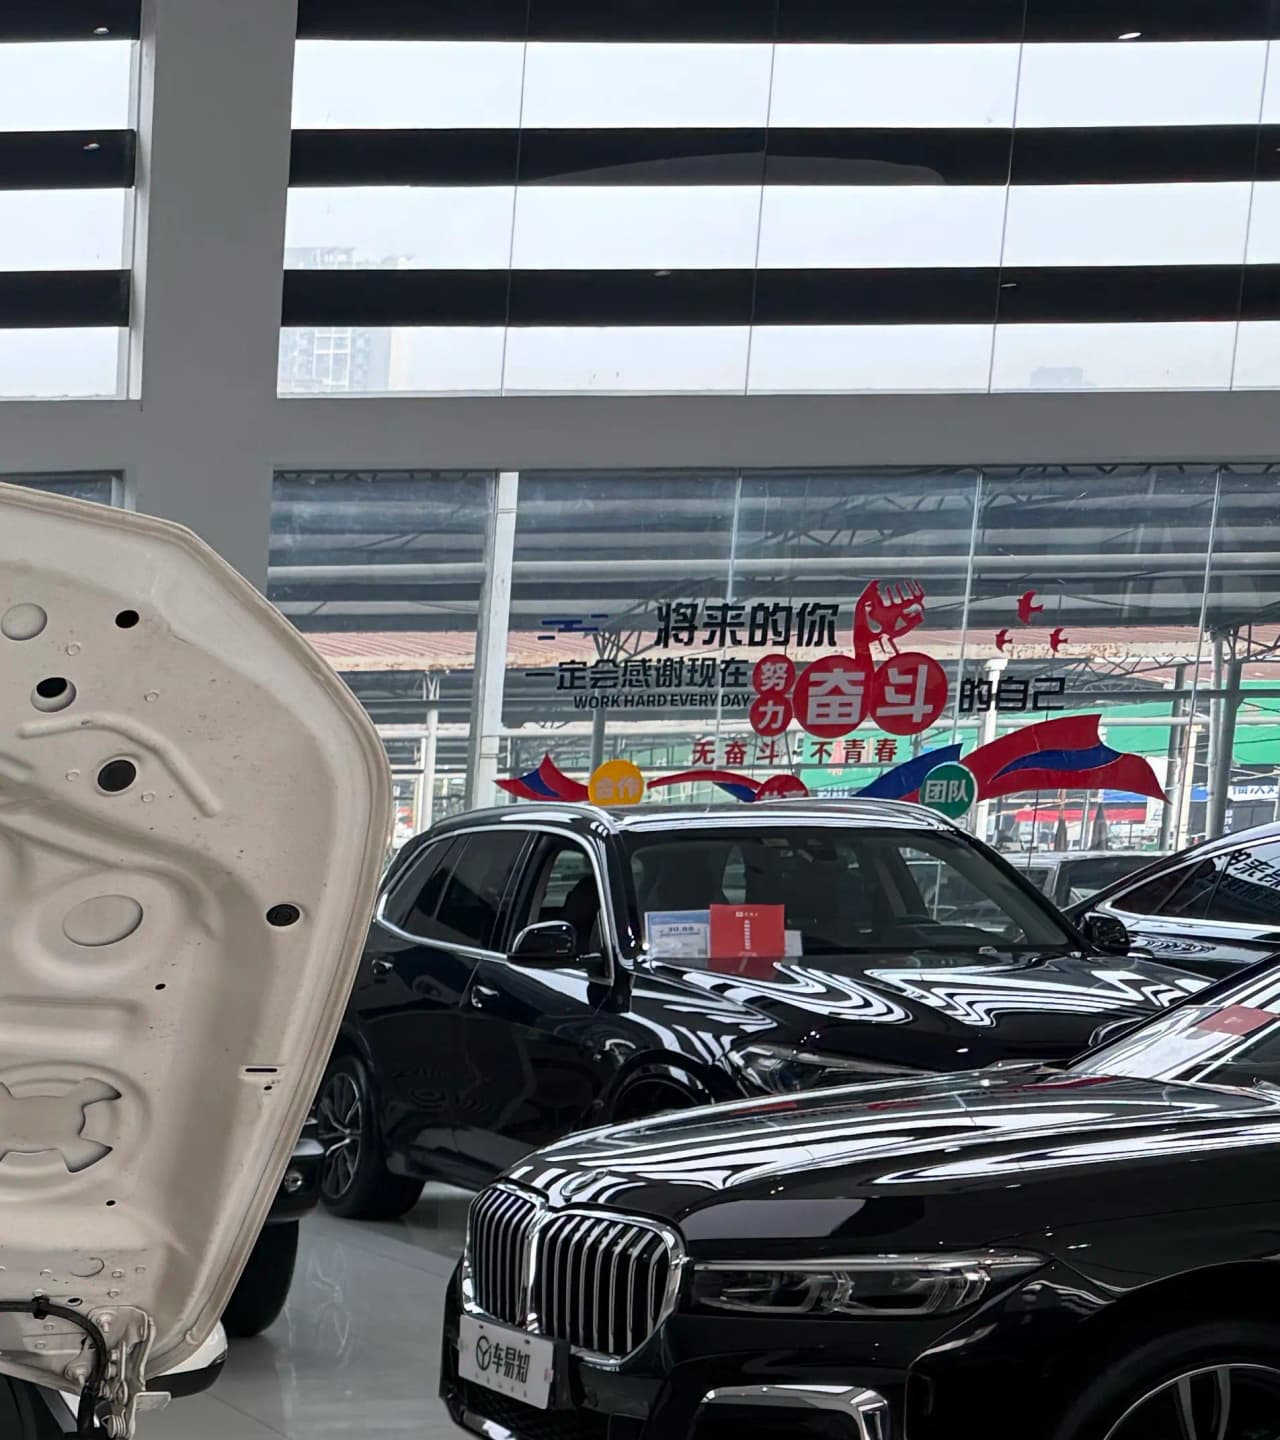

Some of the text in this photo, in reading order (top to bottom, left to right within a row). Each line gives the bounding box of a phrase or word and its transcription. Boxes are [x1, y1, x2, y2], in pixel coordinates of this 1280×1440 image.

[656, 602, 840, 648] 将来的你
[525, 657, 749, 690] 一定会感谢现在
[805, 663, 935, 726] 奋斗
[957, 675, 1066, 713] 的自己
[574, 694, 751, 709] WORK HARD EVERY DAY
[924, 779, 969, 803] 团队
